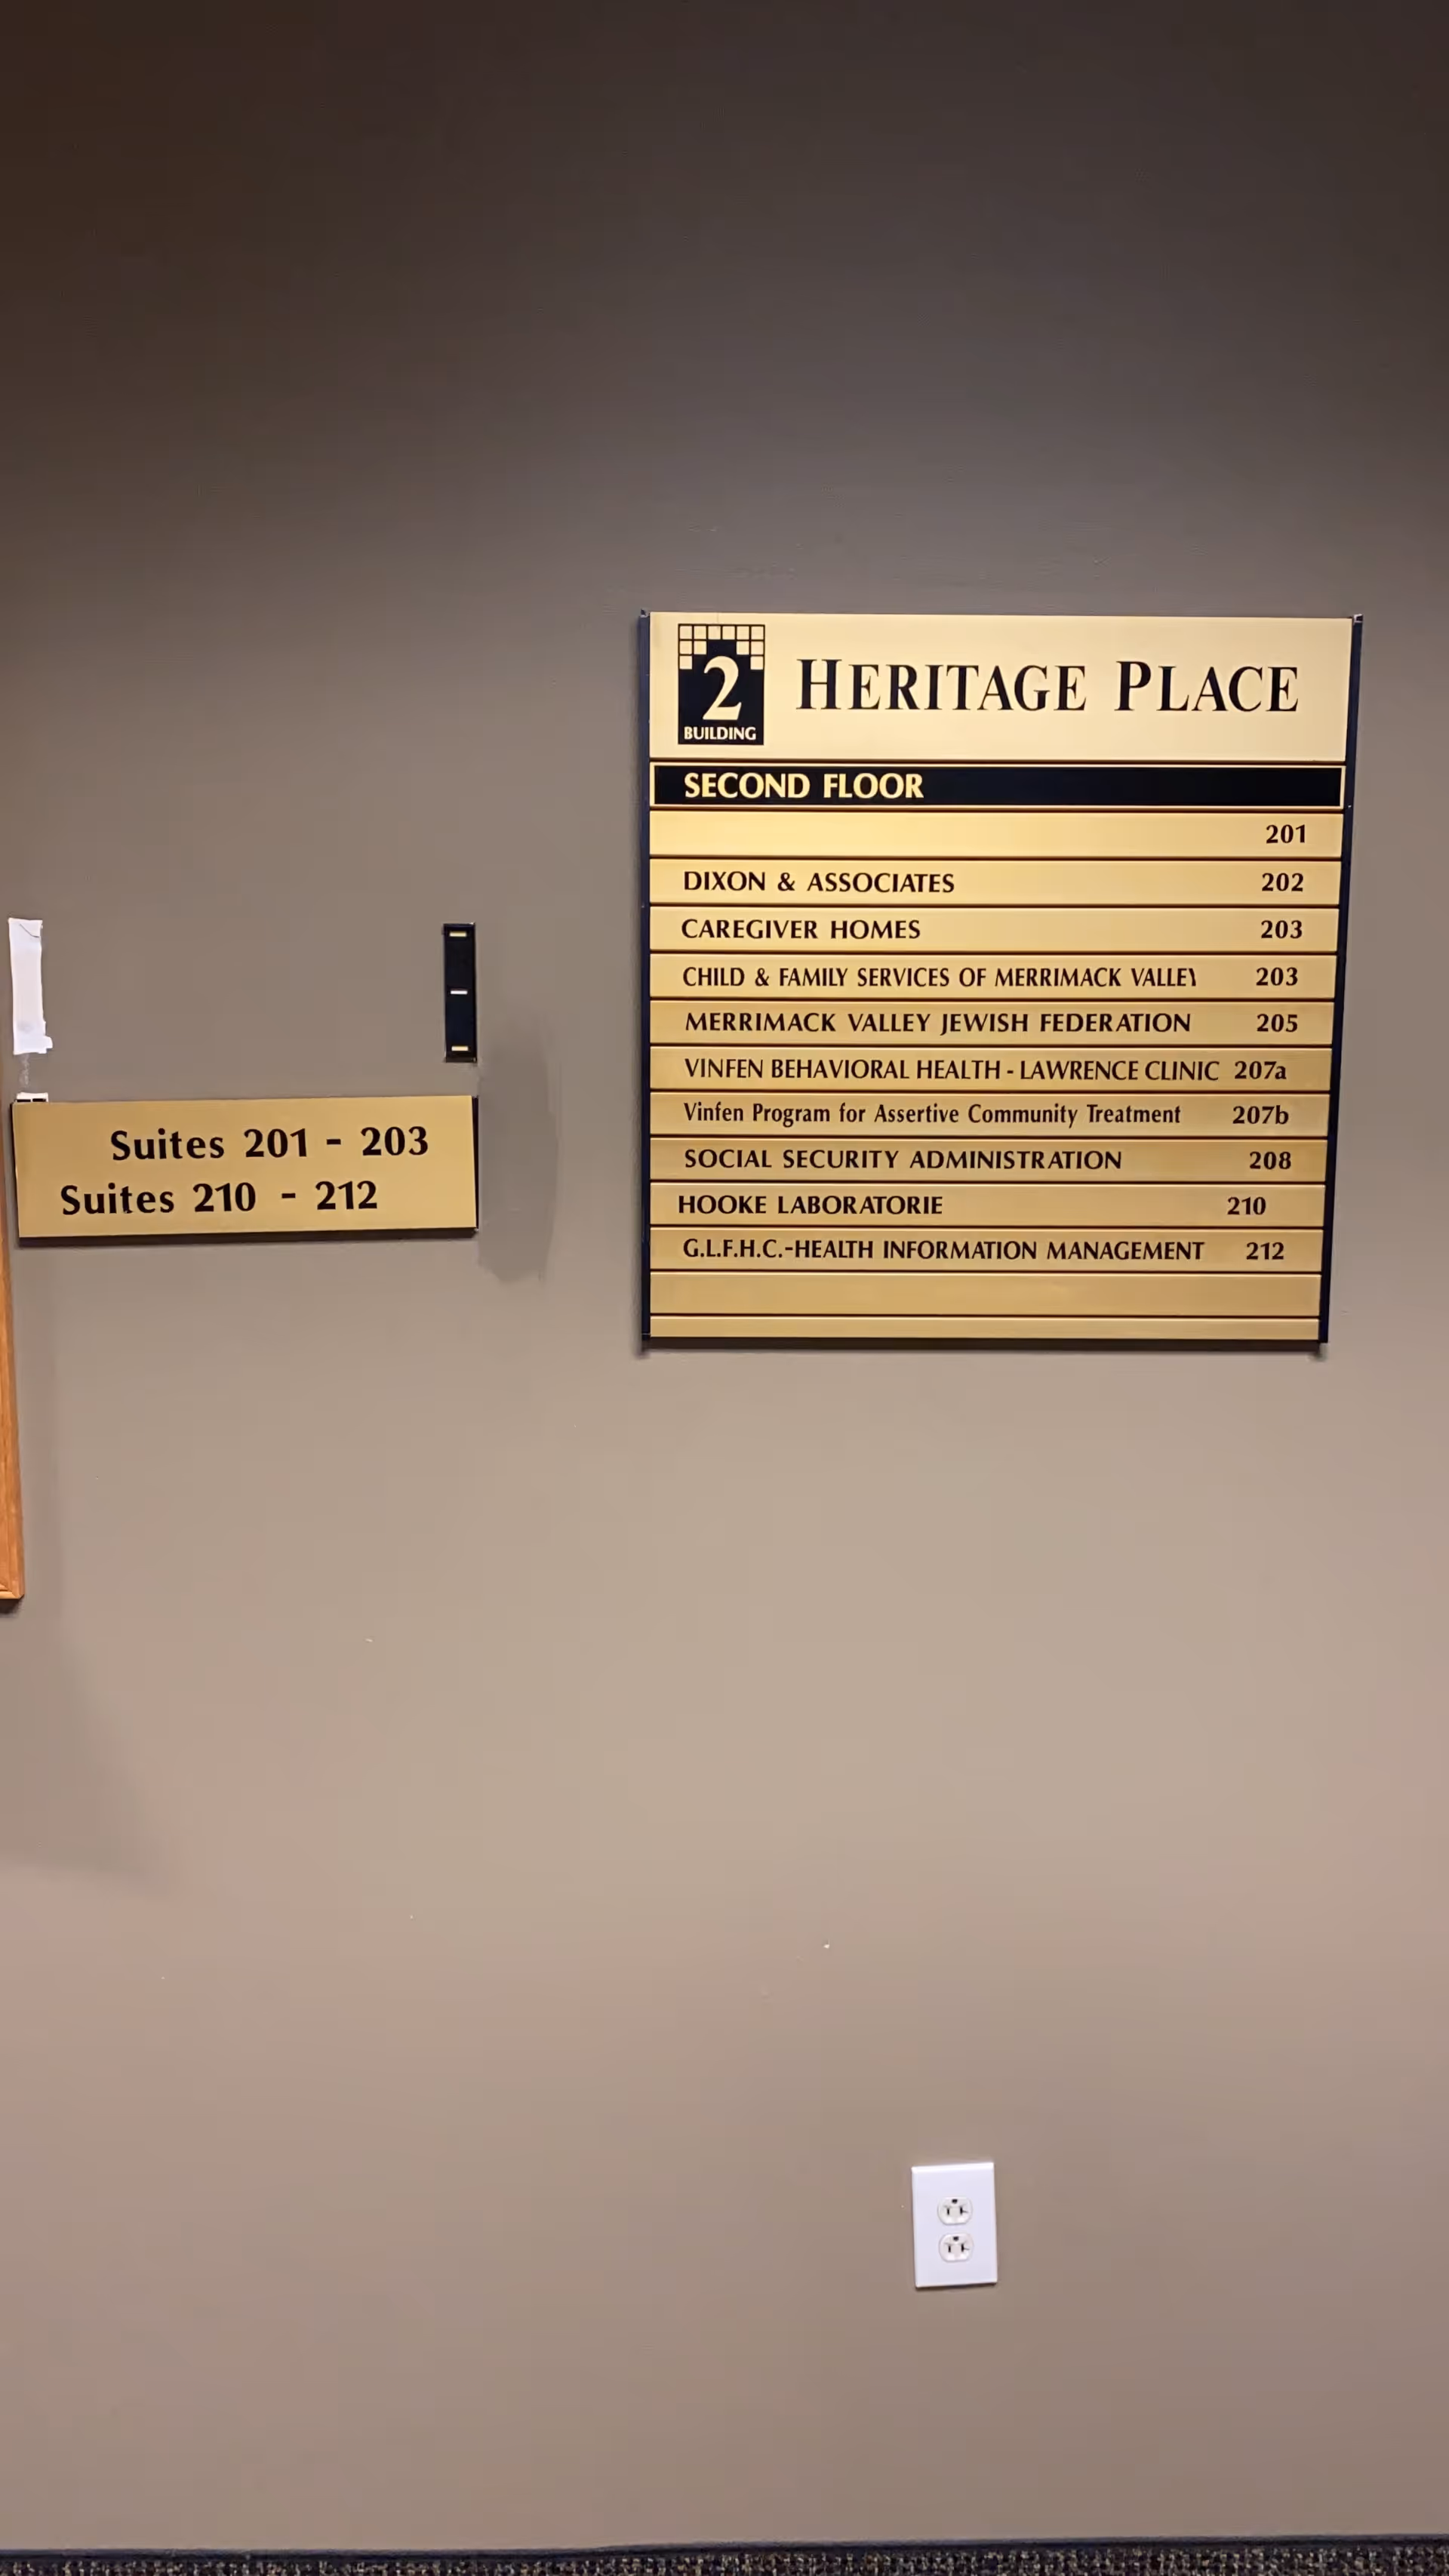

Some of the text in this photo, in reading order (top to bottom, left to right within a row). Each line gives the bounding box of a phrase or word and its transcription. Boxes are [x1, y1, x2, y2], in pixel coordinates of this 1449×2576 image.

[702, 655, 742, 721] 2
[796, 659, 1298, 712] HERITAGE PLACE
[684, 726, 756, 740] BUILDING
[684, 772, 924, 799] SECOND FLOOR
[1266, 824, 1306, 844] 201
[684, 871, 955, 893] DIXON & ASSOCIATES
[1261, 873, 1304, 892] 202
[681, 919, 921, 940] CAREGIVER HOMES
[1261, 919, 1303, 939] 203
[682, 966, 745, 986] CHILD
[755, 968, 770, 987] &
[780, 968, 848, 986] FAMILY
[857, 967, 949, 987] SERVICES
[958, 967, 986, 987] OF
[995, 967, 1121, 987] MERRIMACK
[1256, 967, 1298, 986] 203
[685, 1012, 1191, 1036] MERRIMACK VALLEY JEWISH FEDERATION
[1257, 1013, 1298, 1033] 205
[685, 1058, 764, 1079] VINFEN
[771, 1059, 909, 1079] BEHAVIORAL
[917, 1060, 1001, 1079] HEALTH
[1020, 1060, 1139, 1081] LAWRENCE
[1145, 1060, 1220, 1081] CLINIC
[1234, 1060, 1287, 1080] 207a
[684, 1101, 1181, 1129] Vinfen Program for Assertive Community Treatment
[1232, 1104, 1289, 1125] 207b
[110, 1128, 225, 1161] Suites
[244, 1128, 307, 1158] 201
[361, 1125, 429, 1156] 203
[685, 1149, 1121, 1170] SOCIAL SECURITY ADMINISTRATION
[1249, 1151, 1291, 1170] 208
[60, 1182, 174, 1215] Suites
[192, 1182, 256, 1212] 210
[315, 1180, 377, 1211] 212
[678, 1195, 943, 1215] HOOKE LABORATORIE
[1227, 1196, 1266, 1215] 210
[683, 1238, 1205, 1260] G.L.F.H.C.-HEALTH INFORMATION MANAGEMENT
[1246, 1242, 1284, 1260] 212
